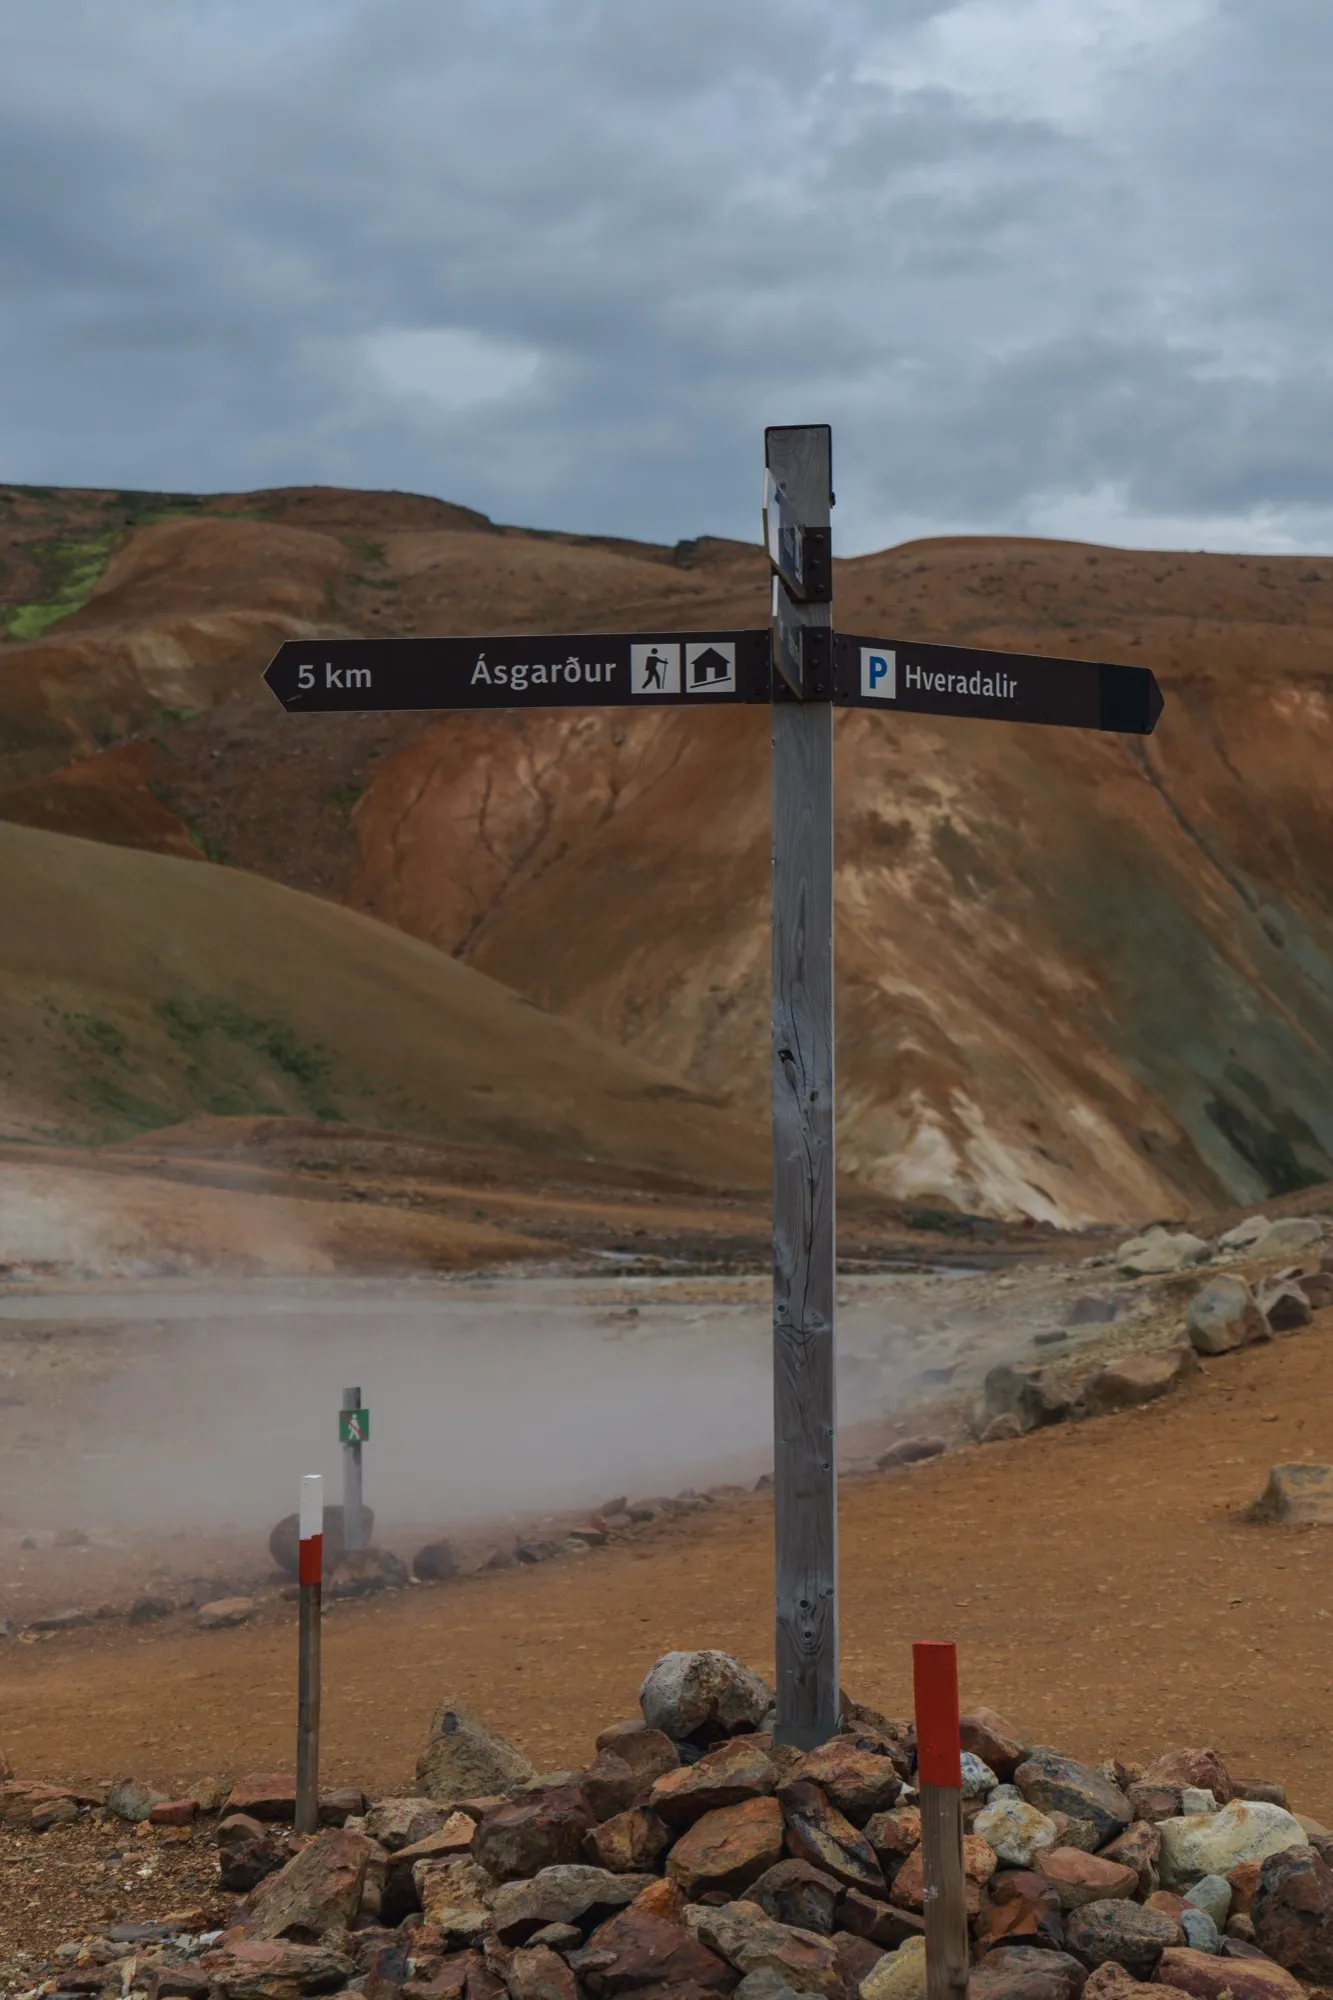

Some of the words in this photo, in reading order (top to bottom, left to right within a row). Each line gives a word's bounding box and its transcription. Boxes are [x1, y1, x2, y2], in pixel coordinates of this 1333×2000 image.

[298, 664, 315, 689] 5
[325, 663, 372, 688] km
[470, 653, 617, 691] Ásgarður
[869, 656, 888, 689] P
[905, 665, 1017, 698] Hveradalir
